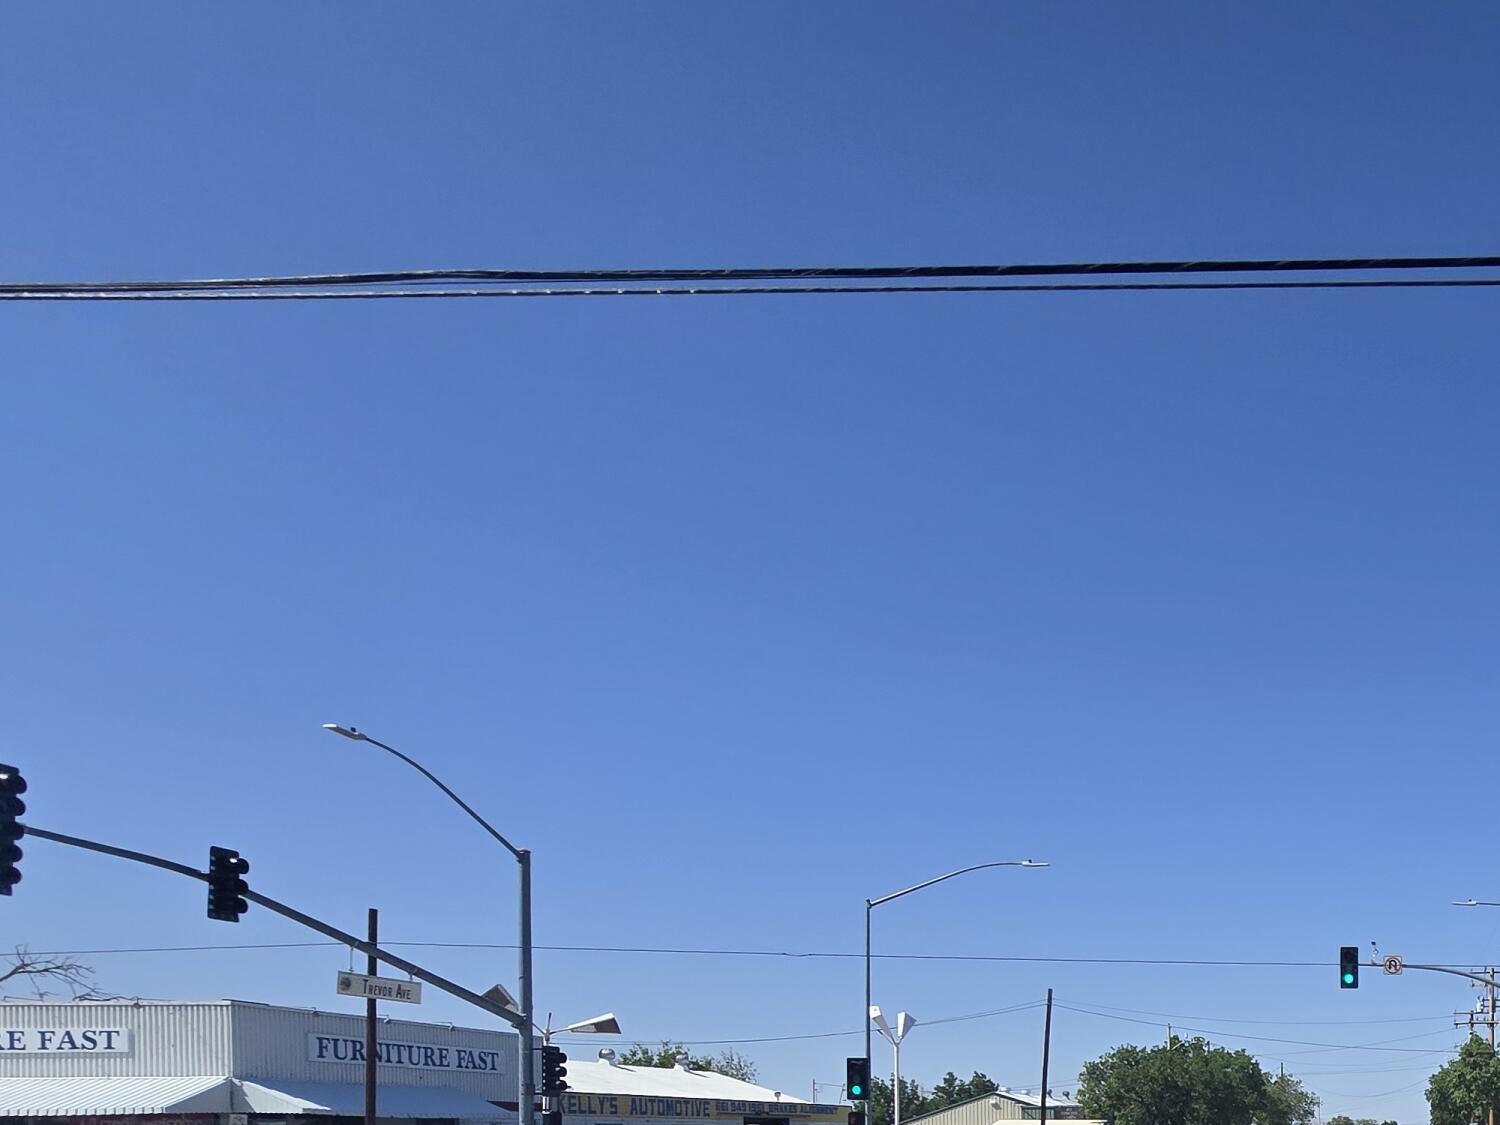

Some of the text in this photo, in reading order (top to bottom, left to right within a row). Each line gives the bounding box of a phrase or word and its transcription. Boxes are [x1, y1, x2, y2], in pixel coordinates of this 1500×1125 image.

[362, 978, 412, 1000] TREVOR AVE
[0, 1030, 120, 1051] E FAST
[455, 1049, 499, 1071] FAST
[630, 1099, 711, 1117] AUTOMOTIVE
